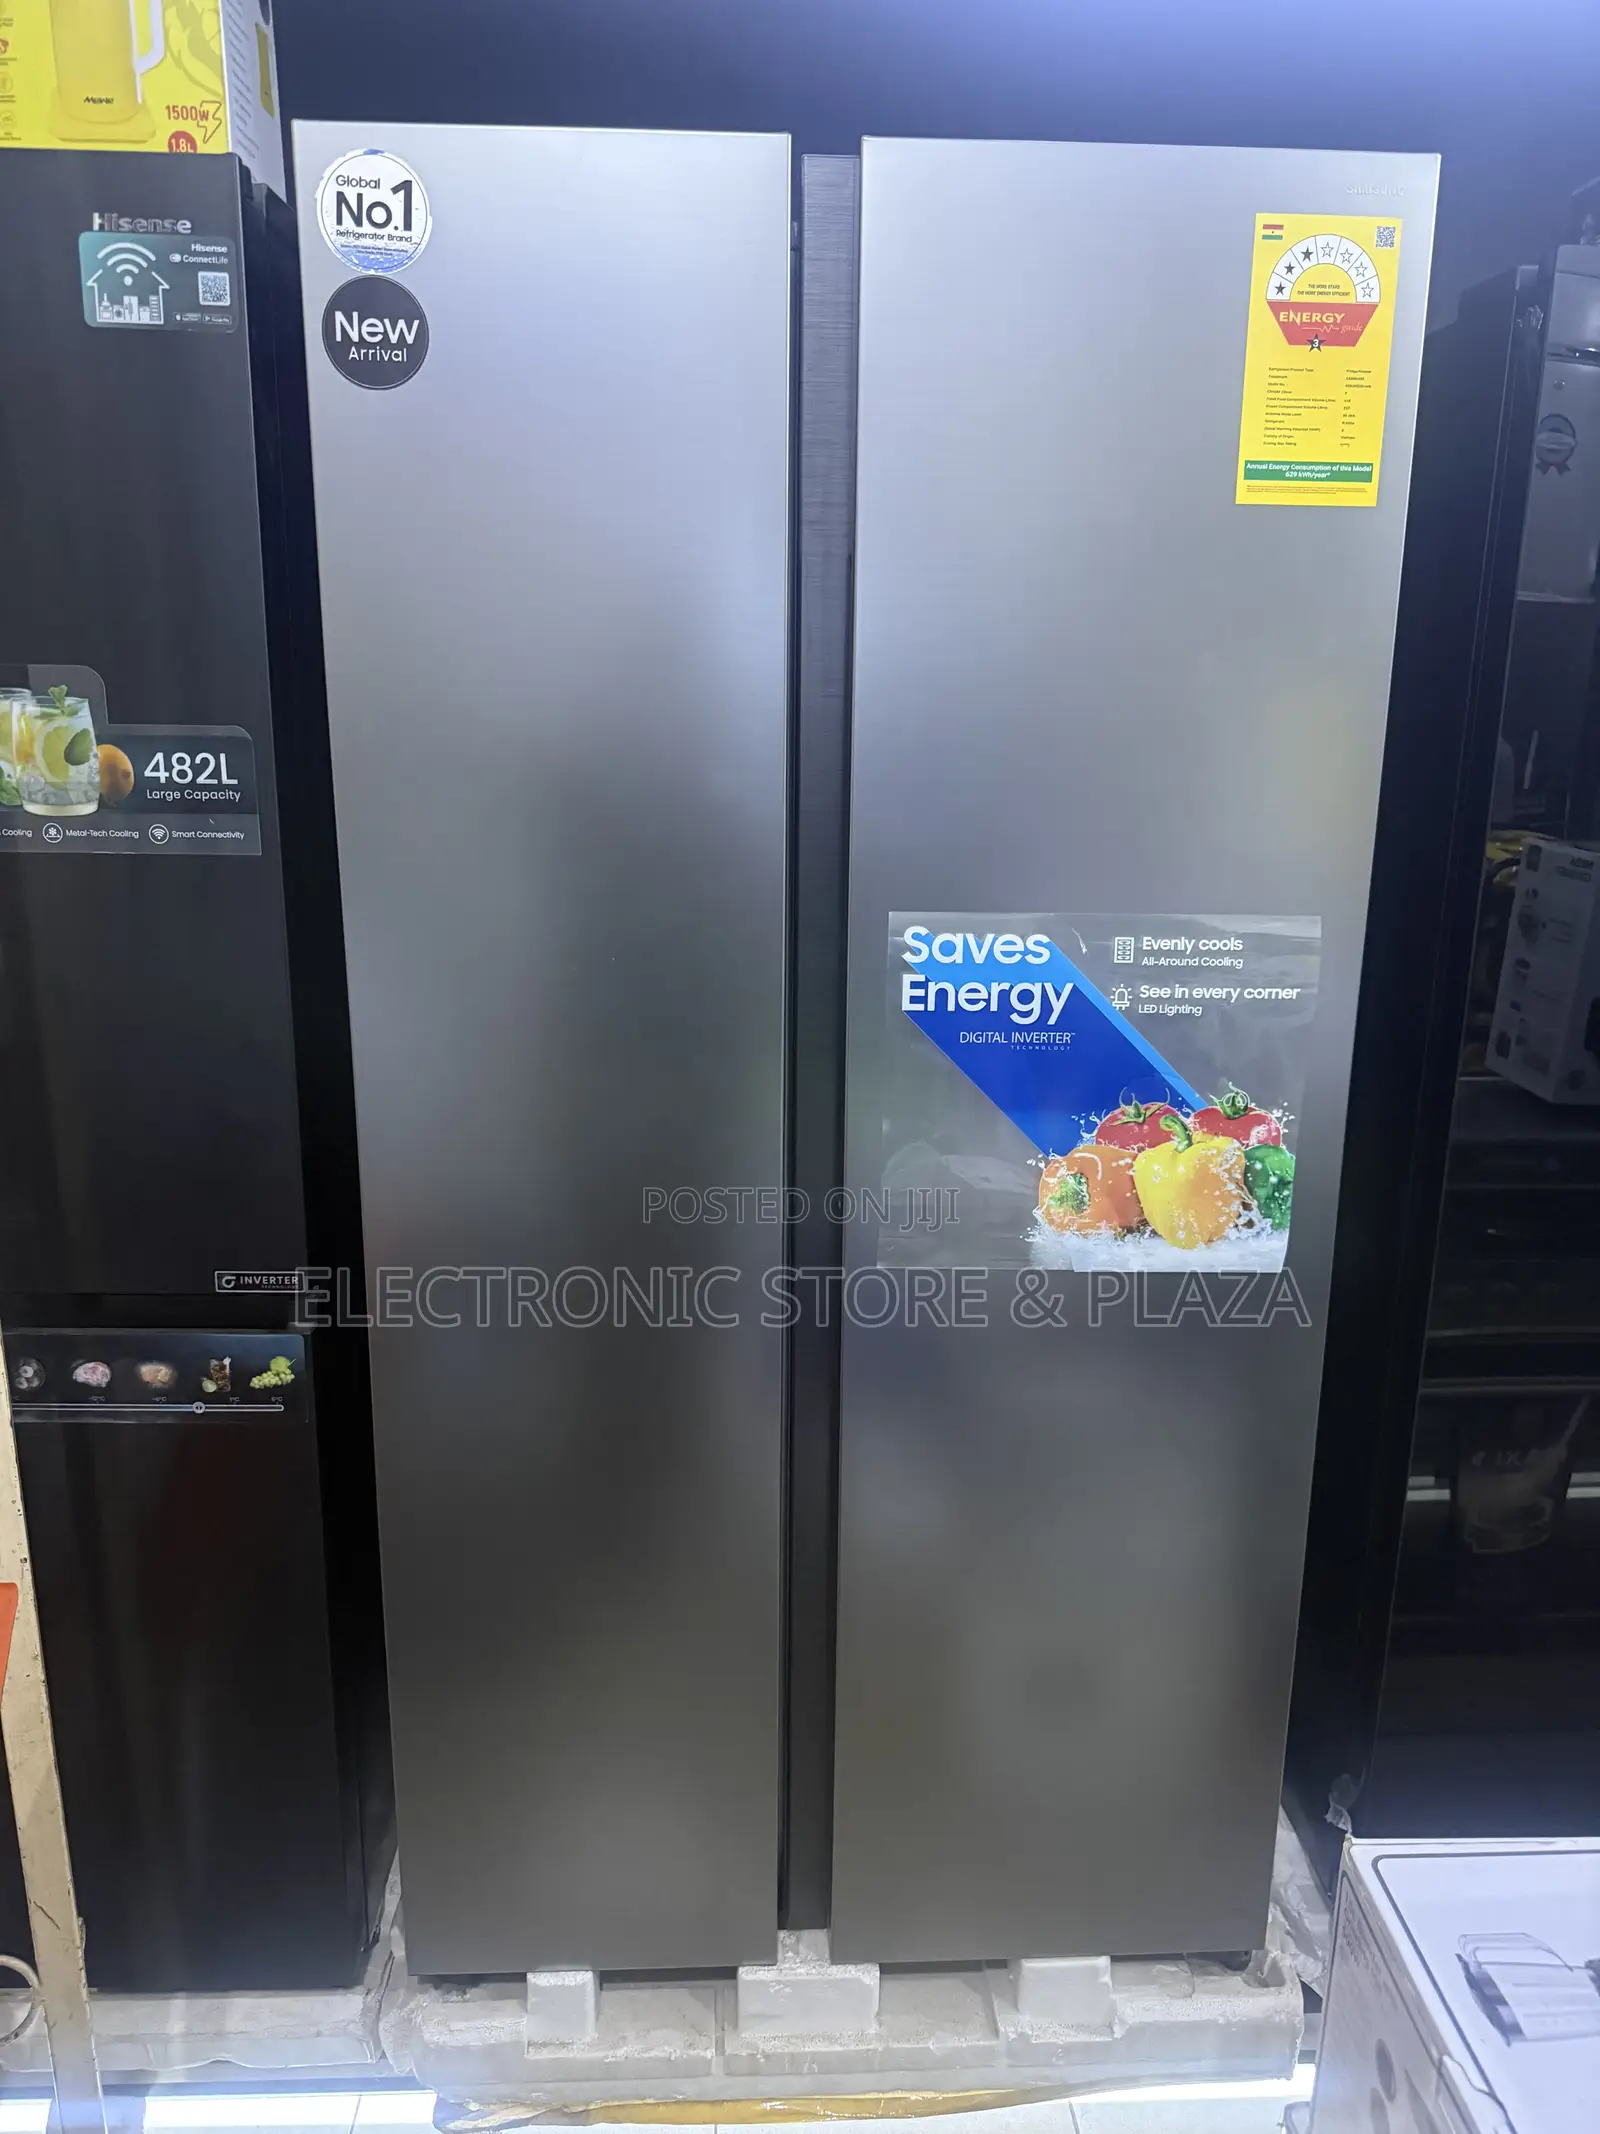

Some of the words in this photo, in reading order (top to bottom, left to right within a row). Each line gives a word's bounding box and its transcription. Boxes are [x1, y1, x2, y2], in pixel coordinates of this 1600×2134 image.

[336, 174, 380, 189] Global
[92, 212, 192, 234] Hisense
[336, 229, 386, 241] Refrigerator
[387, 233, 412, 243] Brand
[191, 243, 227, 253] Hisense
[183, 254, 228, 264] ConnectLife
[335, 310, 419, 345] New
[1313, 339, 1319, 348] 3
[348, 345, 408, 362] Arrival
[1246, 462, 1268, 470] Annual
[1268, 463, 1290, 471] Energy
[1291, 463, 1331, 472] Consumption
[1340, 464, 1352, 472] this
[1285, 470, 1297, 478] 629
[143, 752, 239, 785] 482L
[146, 789, 181, 802] Large
[184, 789, 241, 803] Capacity
[2, 828, 33, 838] Cooling
[66, 829, 108, 837] Metal-Tech
[109, 829, 140, 839] Cooling
[171, 830, 195, 838] Smart
[196, 830, 245, 840] Connectivity
[901, 925, 1051, 965] Saves
[1142, 936, 1196, 955] Evenly
[1198, 937, 1244, 951] cools
[1142, 956, 1199, 967] All-Around
[1201, 957, 1244, 970] Cooling
[901, 973, 1074, 1025] Energy
[1139, 984, 1172, 999] See
[1175, 984, 1188, 999] in
[1192, 987, 1240, 1003] every
[1244, 987, 1301, 1000] corner
[1138, 1004, 1157, 1014] LED
[1159, 1004, 1202, 1016] Lighting
[959, 1031, 1008, 1044] DIGITAL
[240, 1275, 299, 1285] INVERTER
